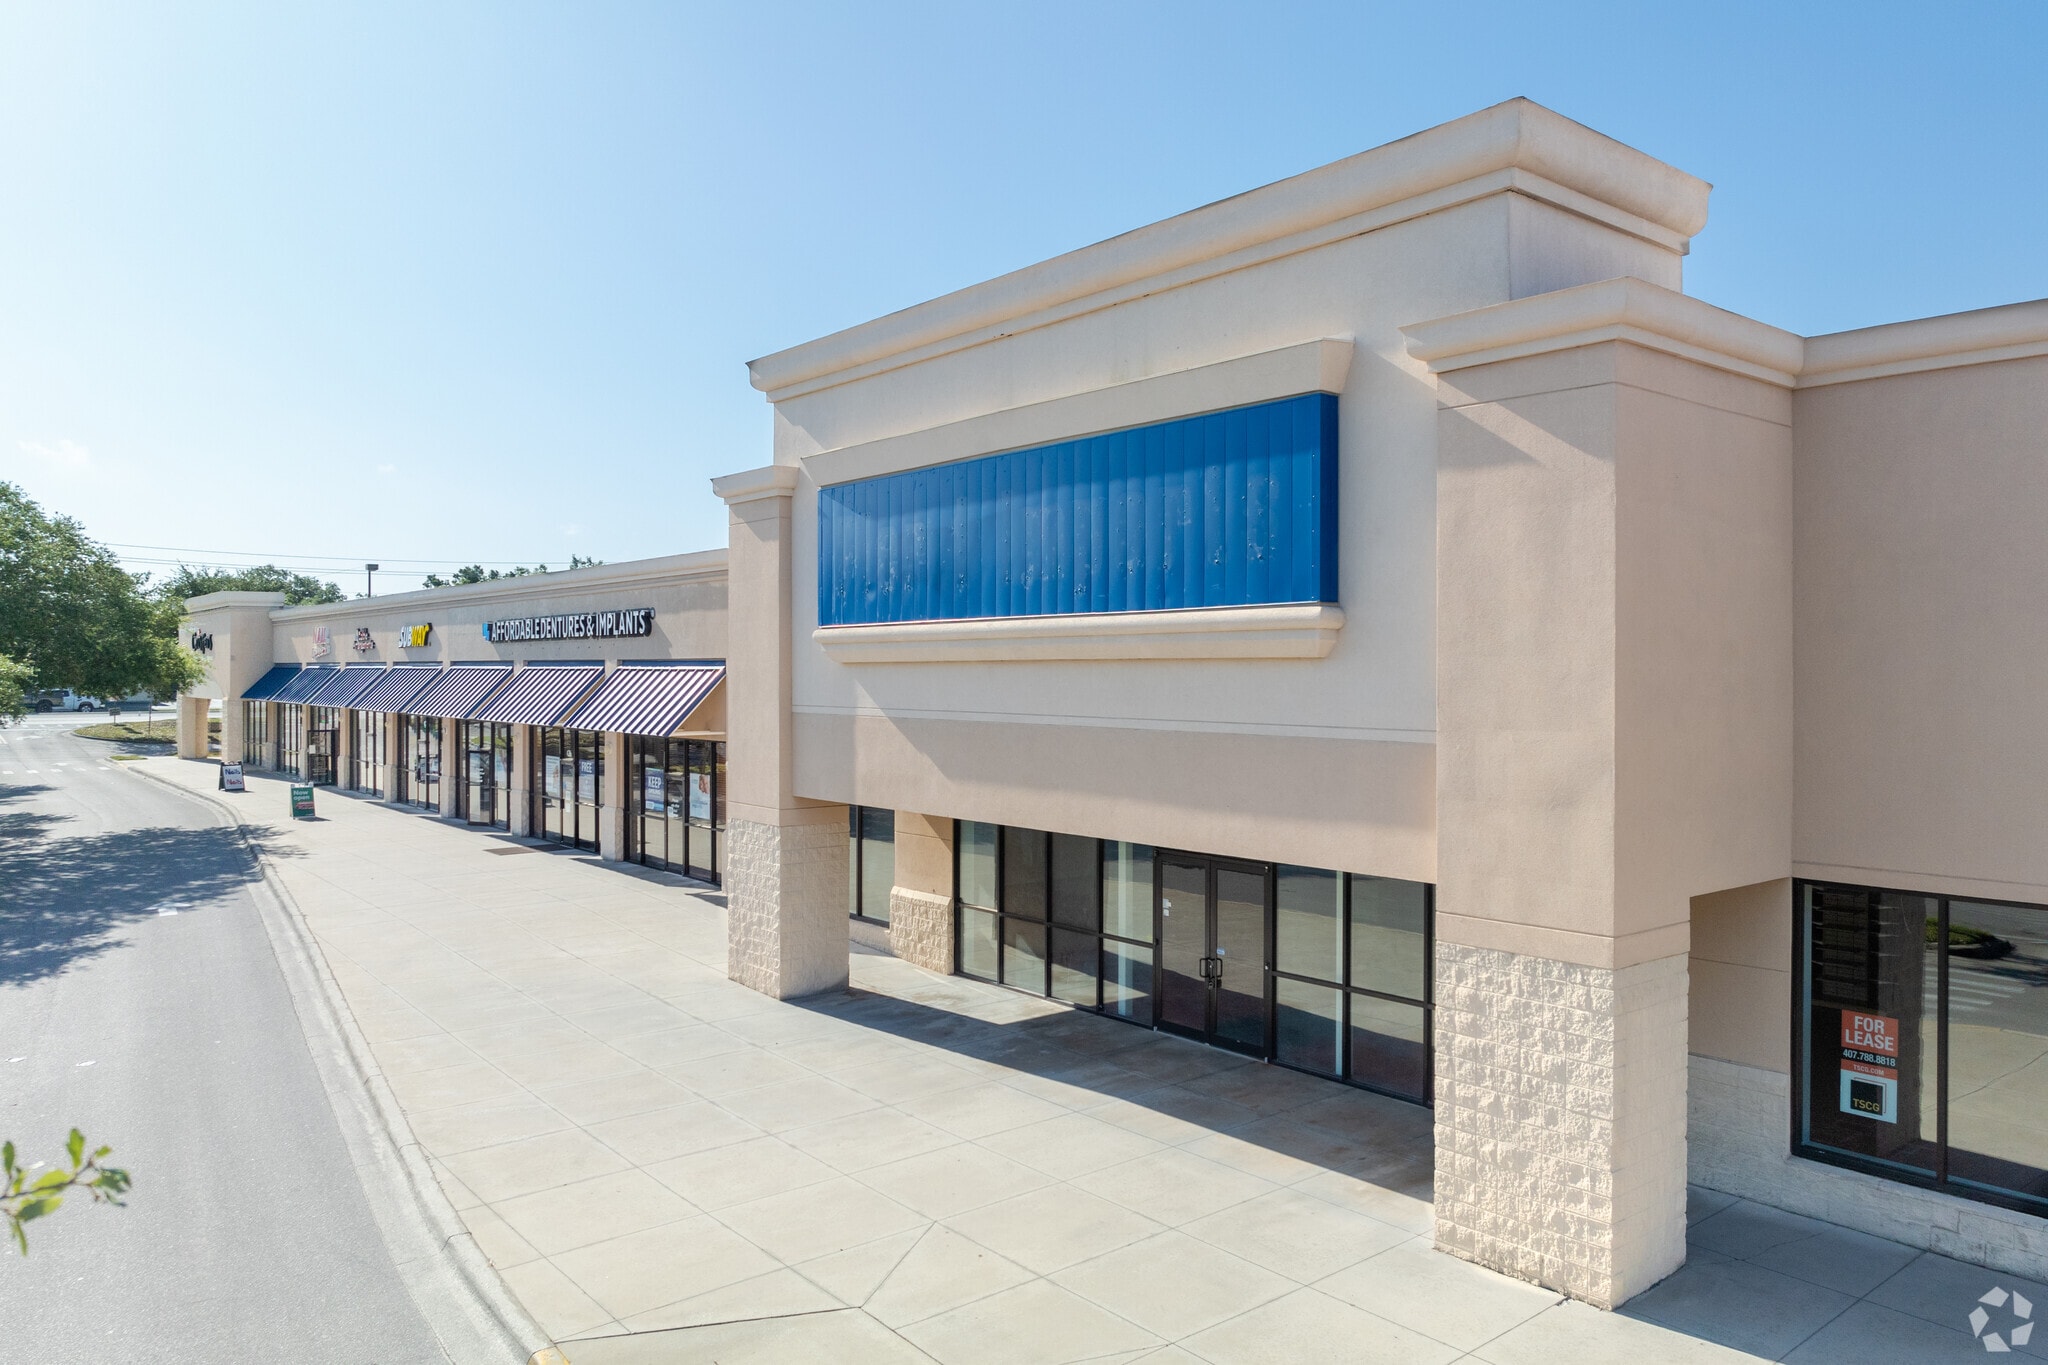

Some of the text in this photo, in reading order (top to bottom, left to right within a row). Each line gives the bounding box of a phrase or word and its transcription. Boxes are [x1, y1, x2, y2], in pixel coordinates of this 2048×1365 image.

[491, 609, 646, 641] AFFORDABLE DENTURES & IMPLANTS
[398, 624, 430, 648] SUBWAY
[581, 761, 593, 773] FREE
[648, 776, 662, 789] KEEP
[1854, 1015, 1885, 1035] FOR
[1845, 1028, 1894, 1052] LEASE
[1843, 1048, 1896, 1067] 407.788.8818
[1852, 1098, 1880, 1112] TSCG
